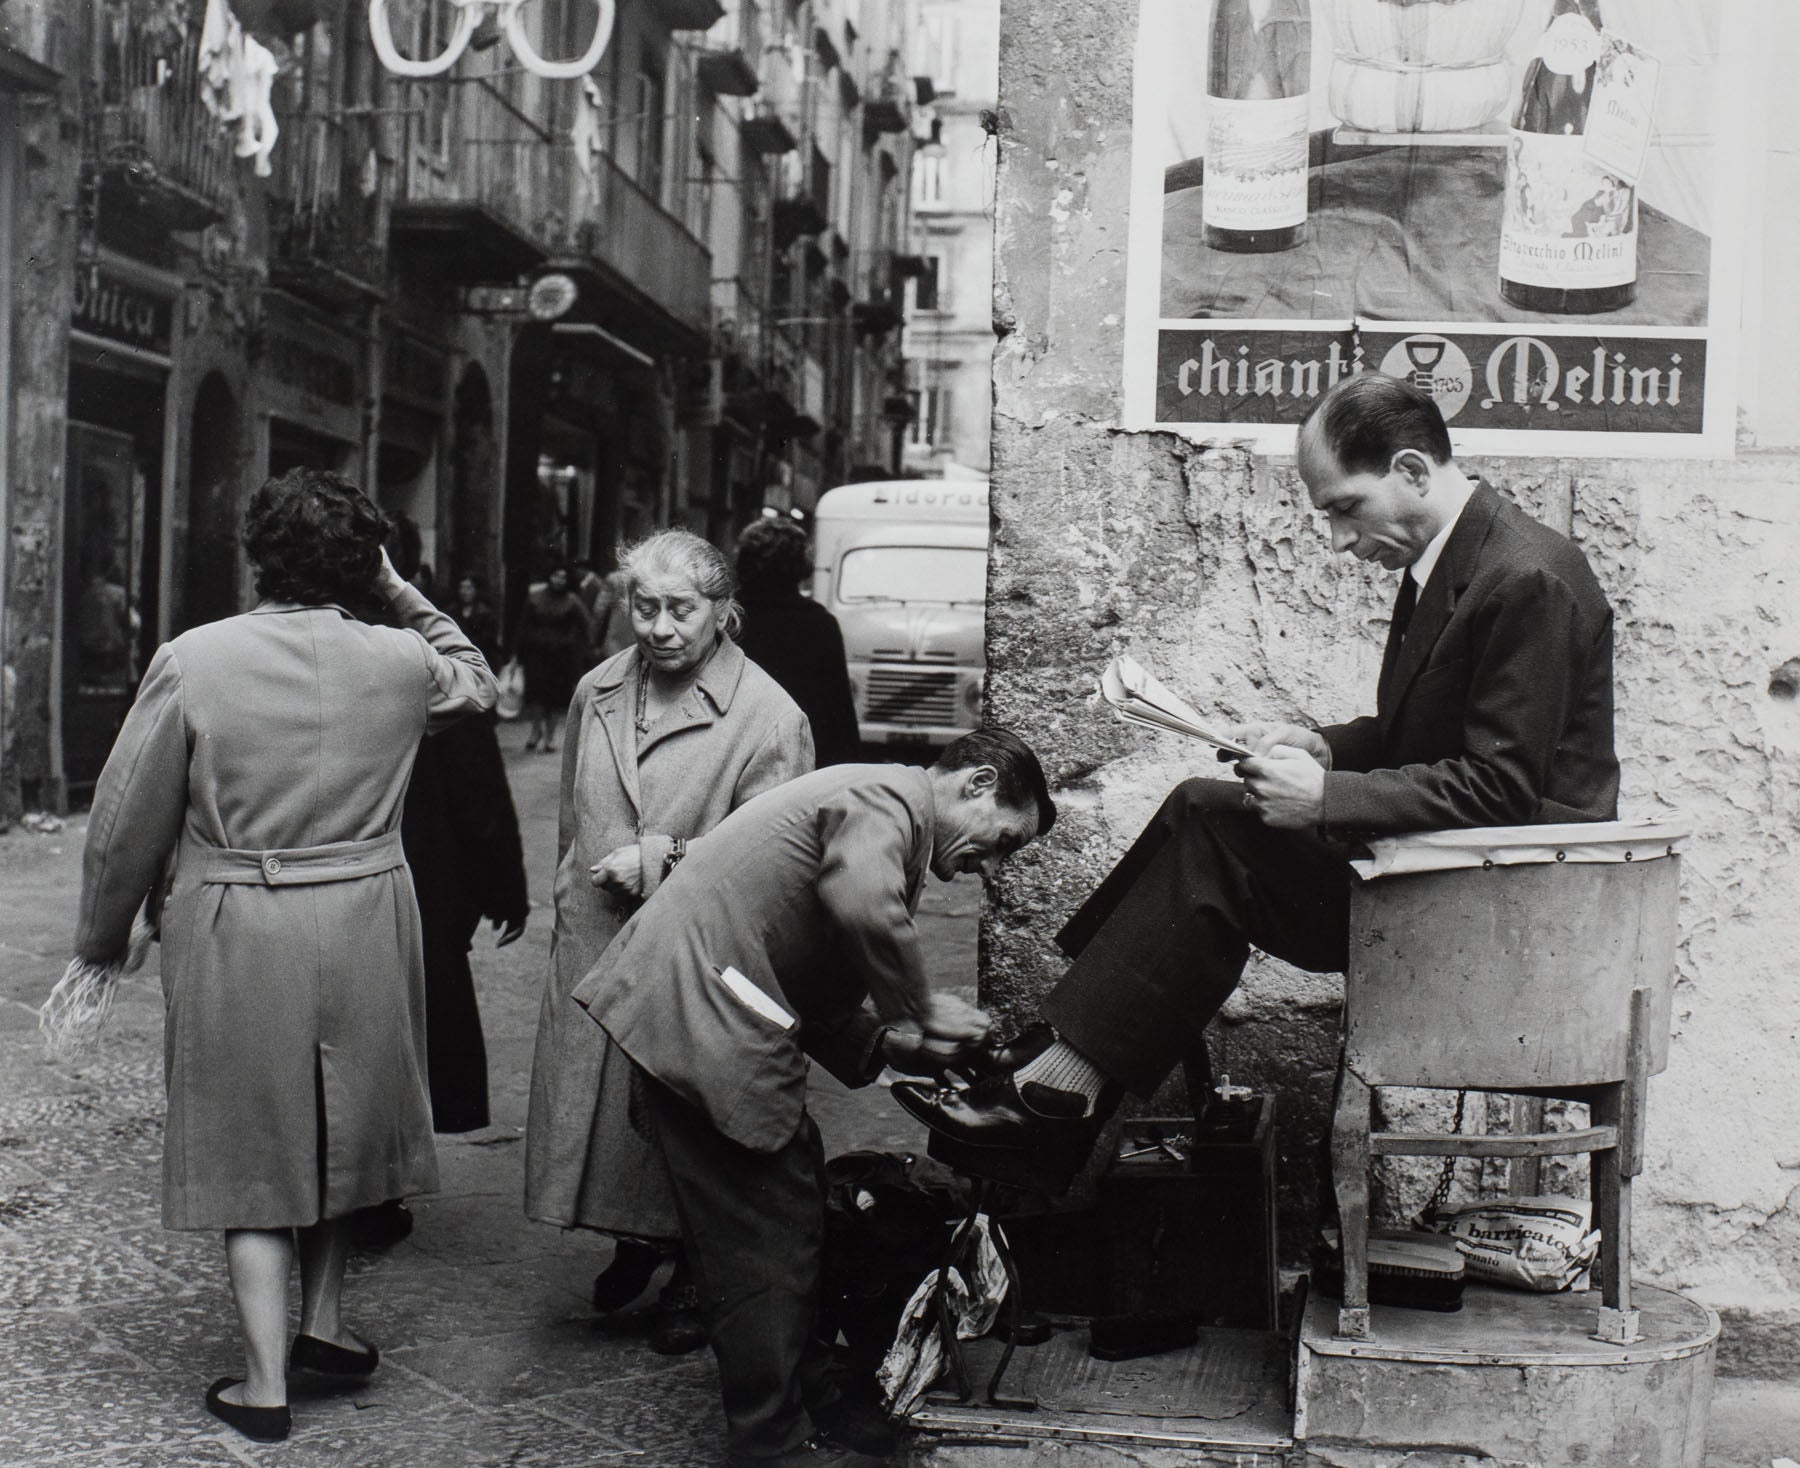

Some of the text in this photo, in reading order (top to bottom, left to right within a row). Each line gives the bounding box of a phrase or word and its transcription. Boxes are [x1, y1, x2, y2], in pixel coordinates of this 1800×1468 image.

[1573, 241, 1623, 261] Melini
[1480, 336, 1683, 411] Melini
[1467, 1223, 1566, 1252] barricato
